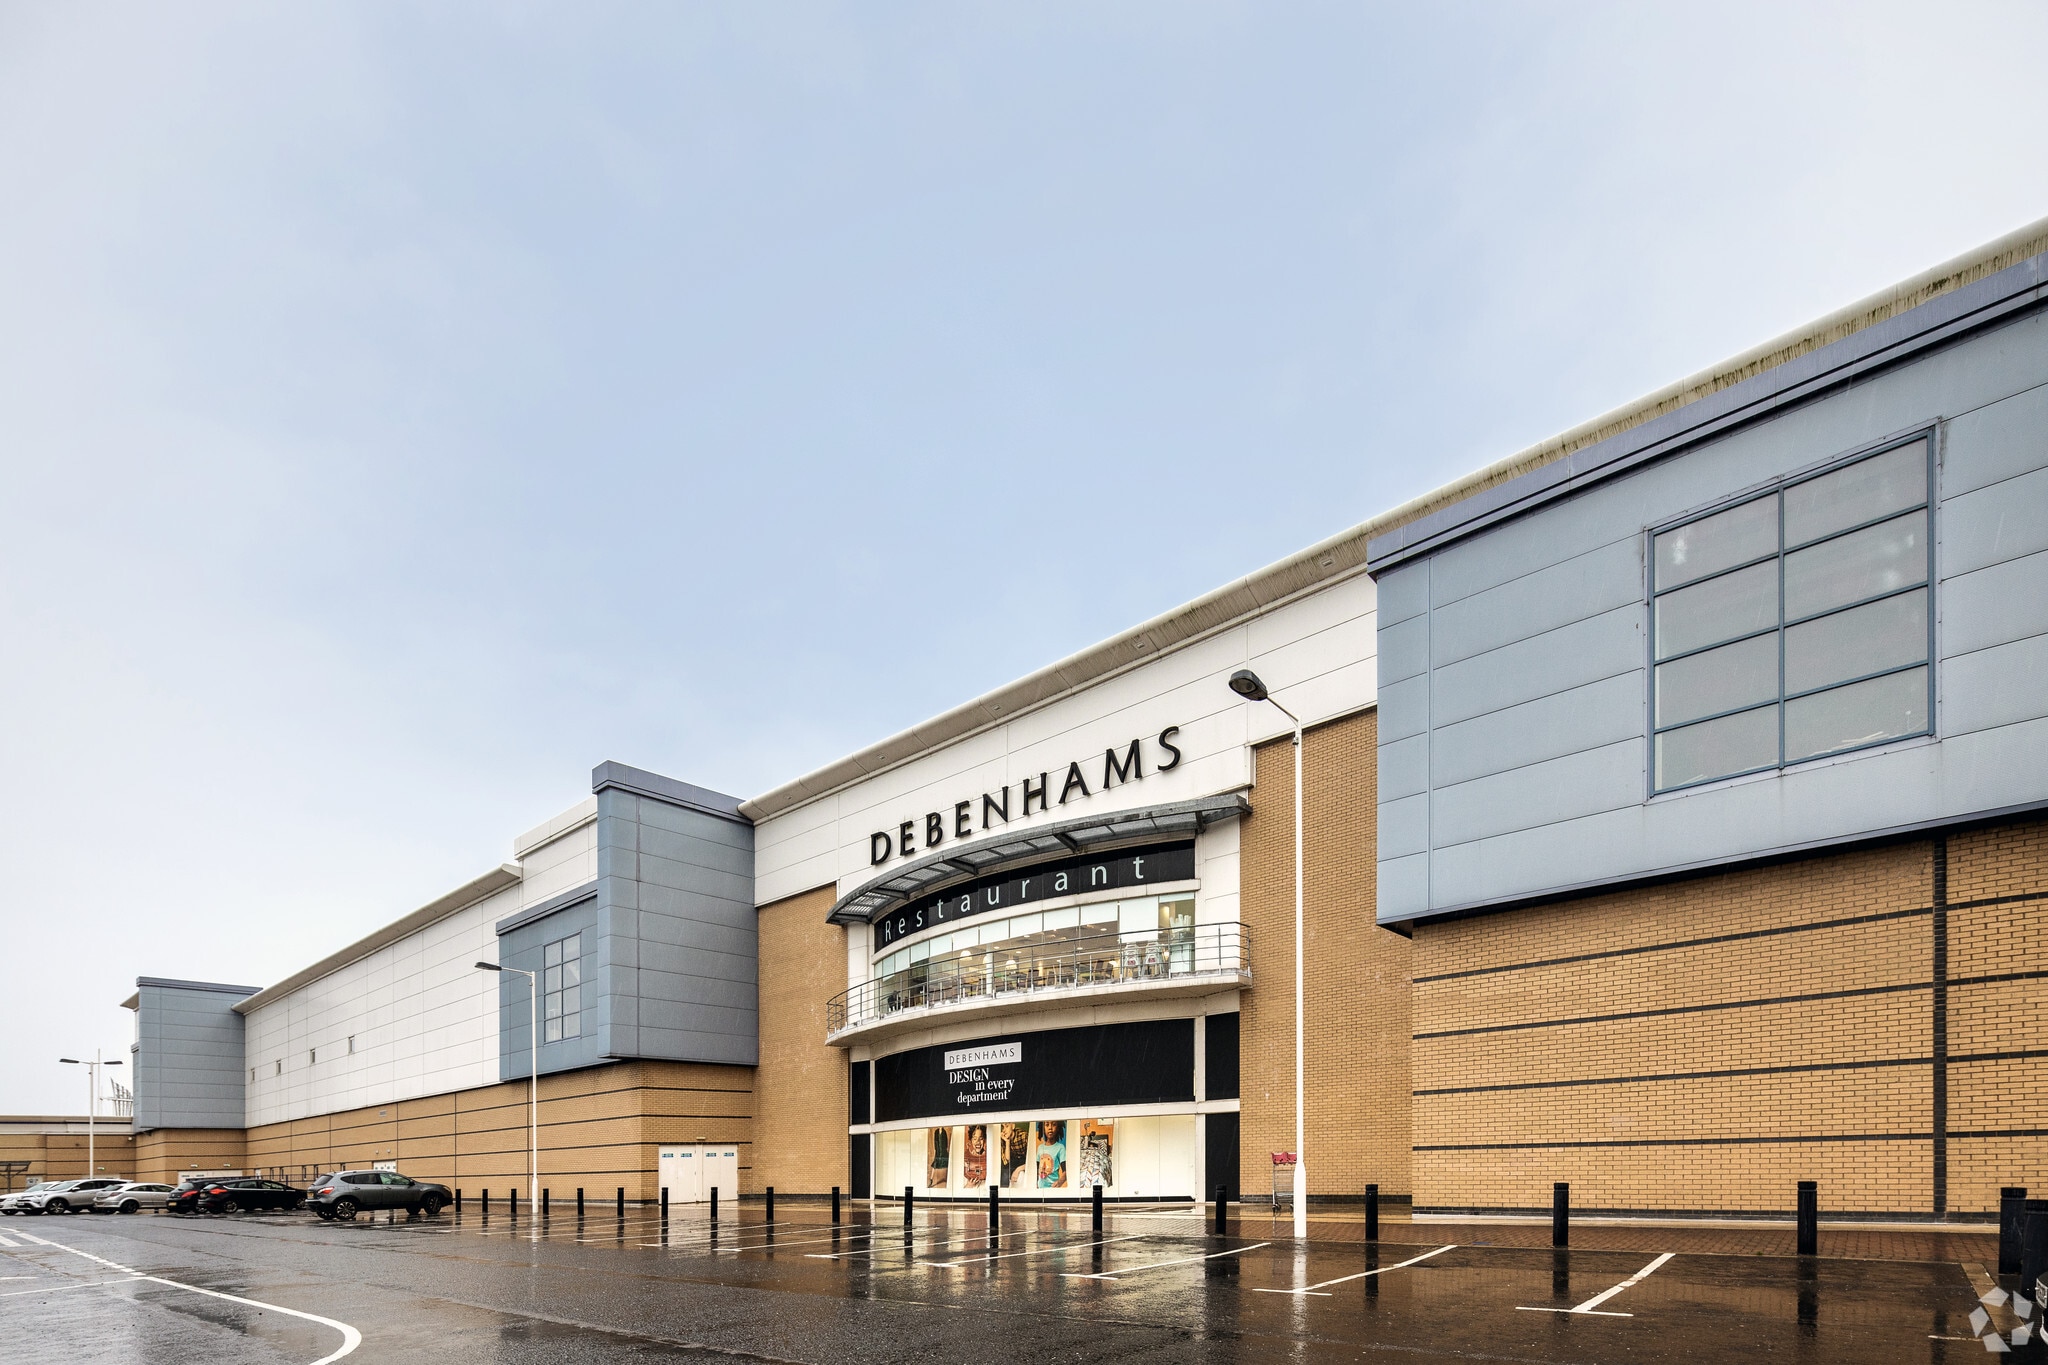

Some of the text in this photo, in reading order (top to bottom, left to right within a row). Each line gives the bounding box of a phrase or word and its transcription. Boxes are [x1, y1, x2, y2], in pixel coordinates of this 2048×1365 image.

[870, 726, 1181, 866] DEBENHAMS
[885, 856, 1145, 942] Restaurant
[949, 1048, 1015, 1065] DEBENHAMS
[949, 1068, 989, 1084] DESIGN
[975, 1079, 1015, 1092] in every
[957, 1090, 1008, 1107] department
